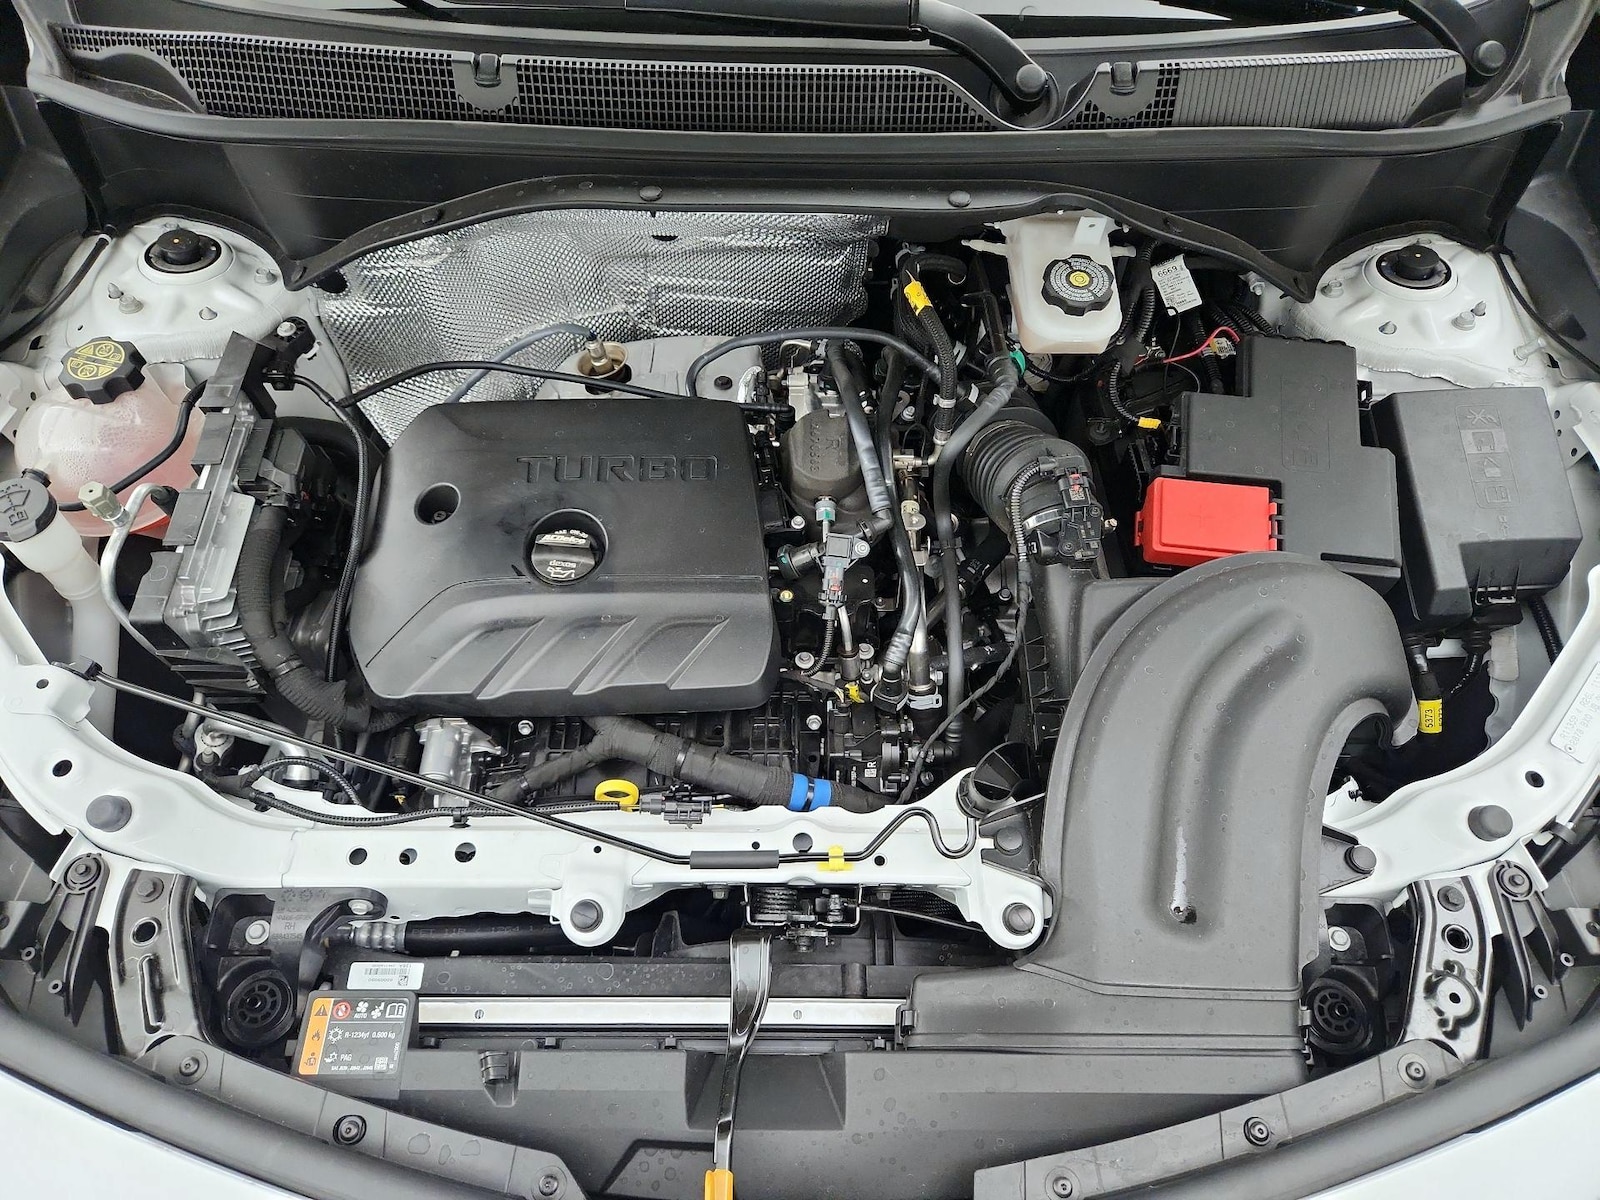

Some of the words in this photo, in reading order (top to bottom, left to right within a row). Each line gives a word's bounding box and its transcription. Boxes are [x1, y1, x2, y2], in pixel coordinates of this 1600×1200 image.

[1157, 265, 1178, 277] 6669
[517, 455, 718, 483] TURBO
[539, 534, 586, 544] ACDelco
[1425, 708, 1434, 728] 5373
[284, 922, 296, 930] RH
